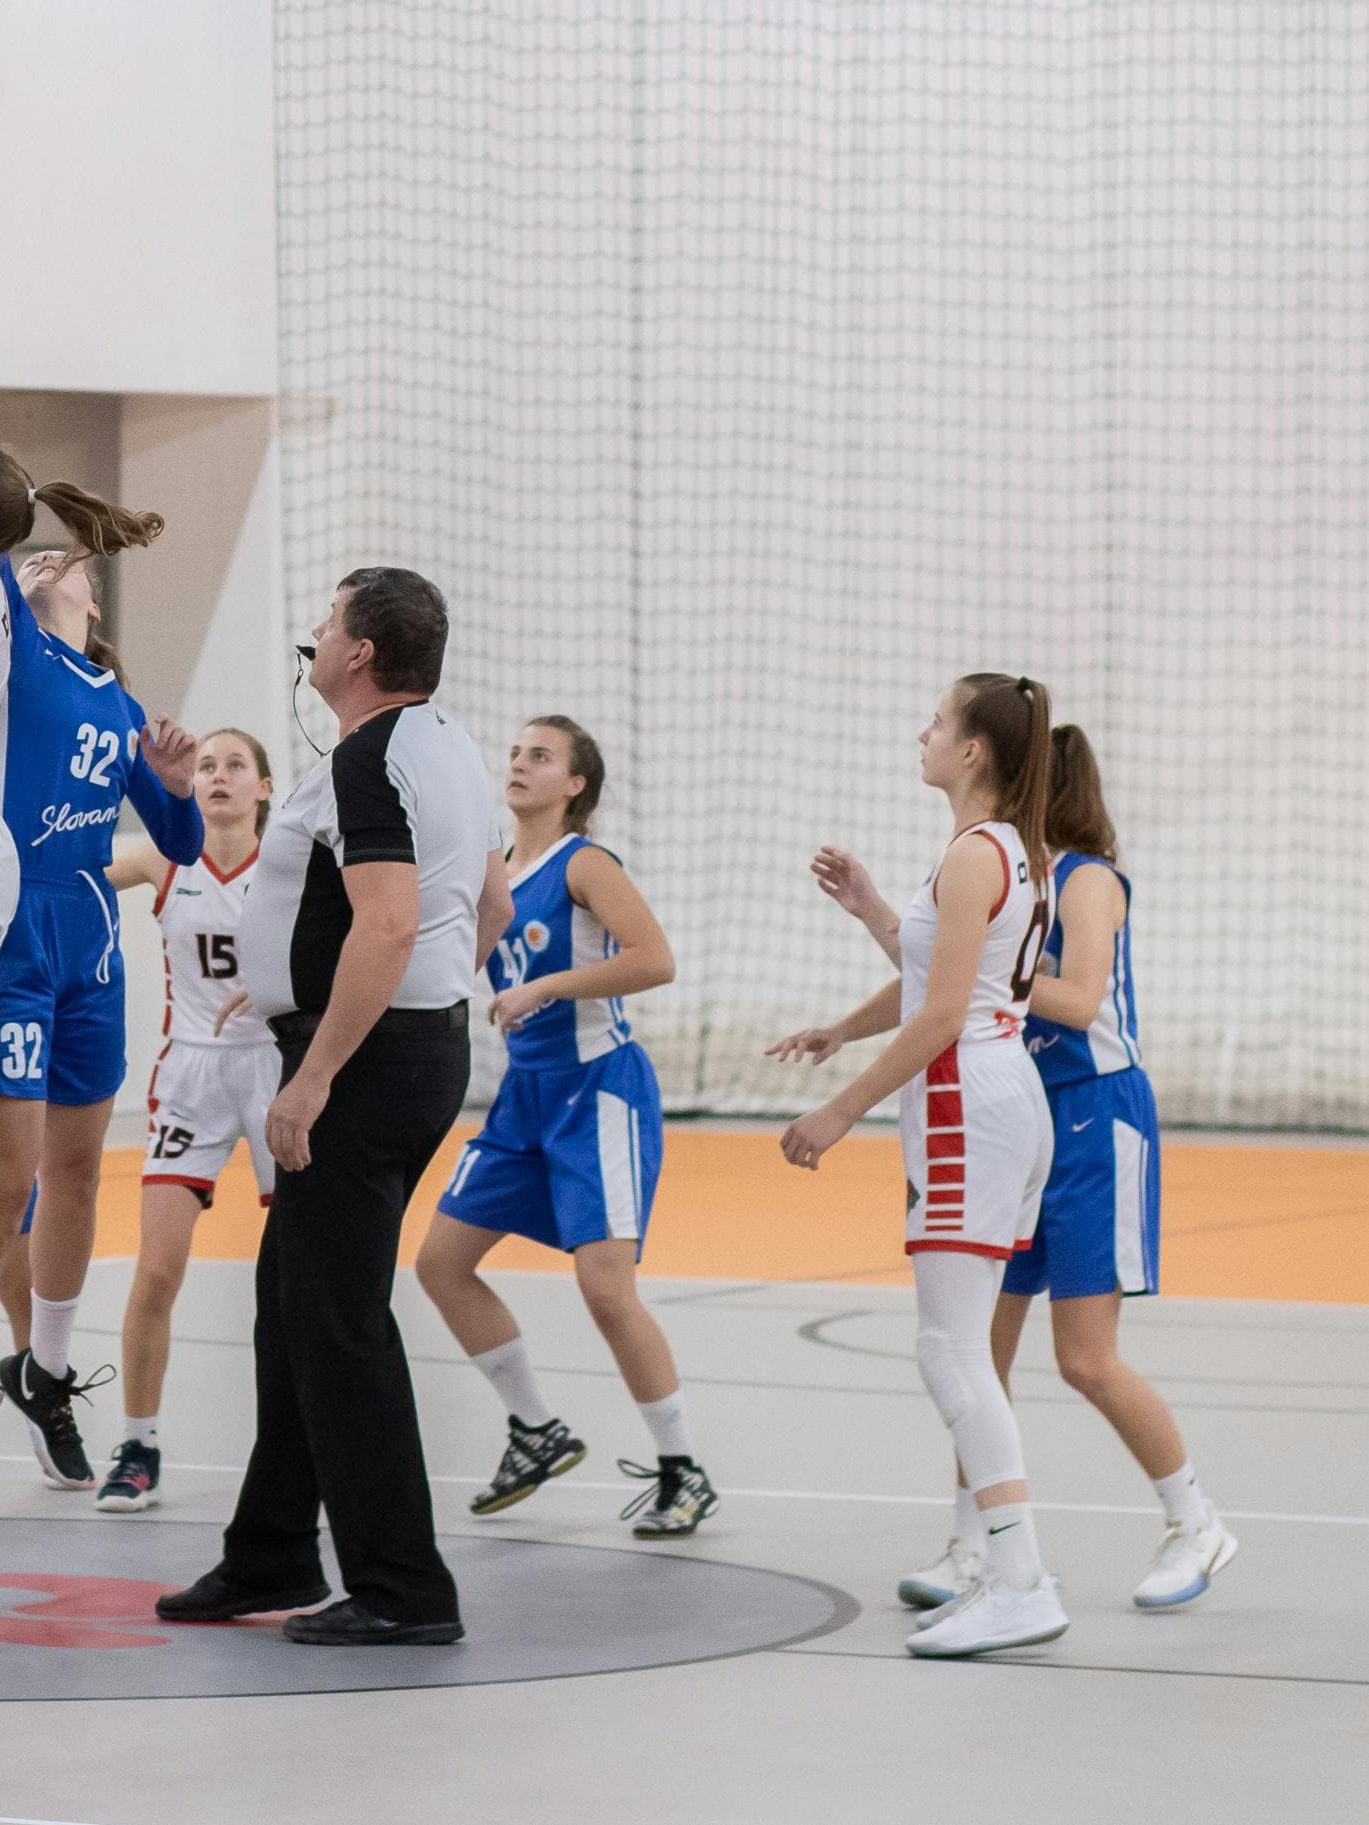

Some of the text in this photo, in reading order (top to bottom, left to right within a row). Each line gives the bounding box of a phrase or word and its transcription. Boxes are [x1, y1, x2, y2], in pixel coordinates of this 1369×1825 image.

[70, 722, 120, 788] 32
[31, 802, 120, 847] Slovan
[195, 933, 239, 979] 15
[0, 1022, 42, 1079] 32
[152, 1125, 196, 1160] 15
